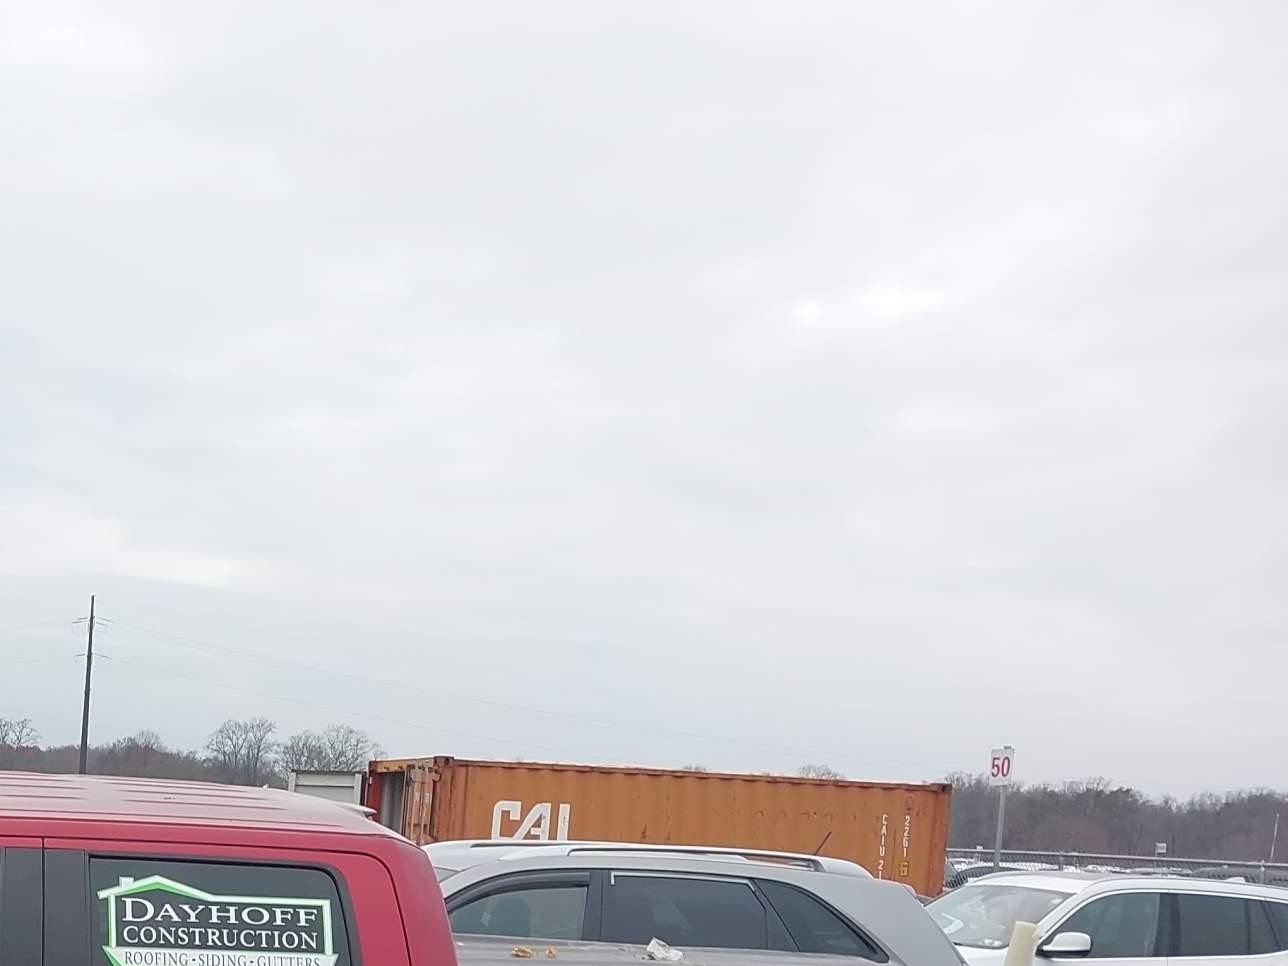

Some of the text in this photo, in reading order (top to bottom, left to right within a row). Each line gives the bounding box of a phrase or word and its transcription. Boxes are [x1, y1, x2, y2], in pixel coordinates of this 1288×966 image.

[992, 756, 1011, 778] 50
[878, 814, 889, 857] CAIU
[121, 897, 318, 927] DAYHOFF
[122, 925, 318, 949] CONSTRUCTION
[124, 951, 189, 966] ROOFING
